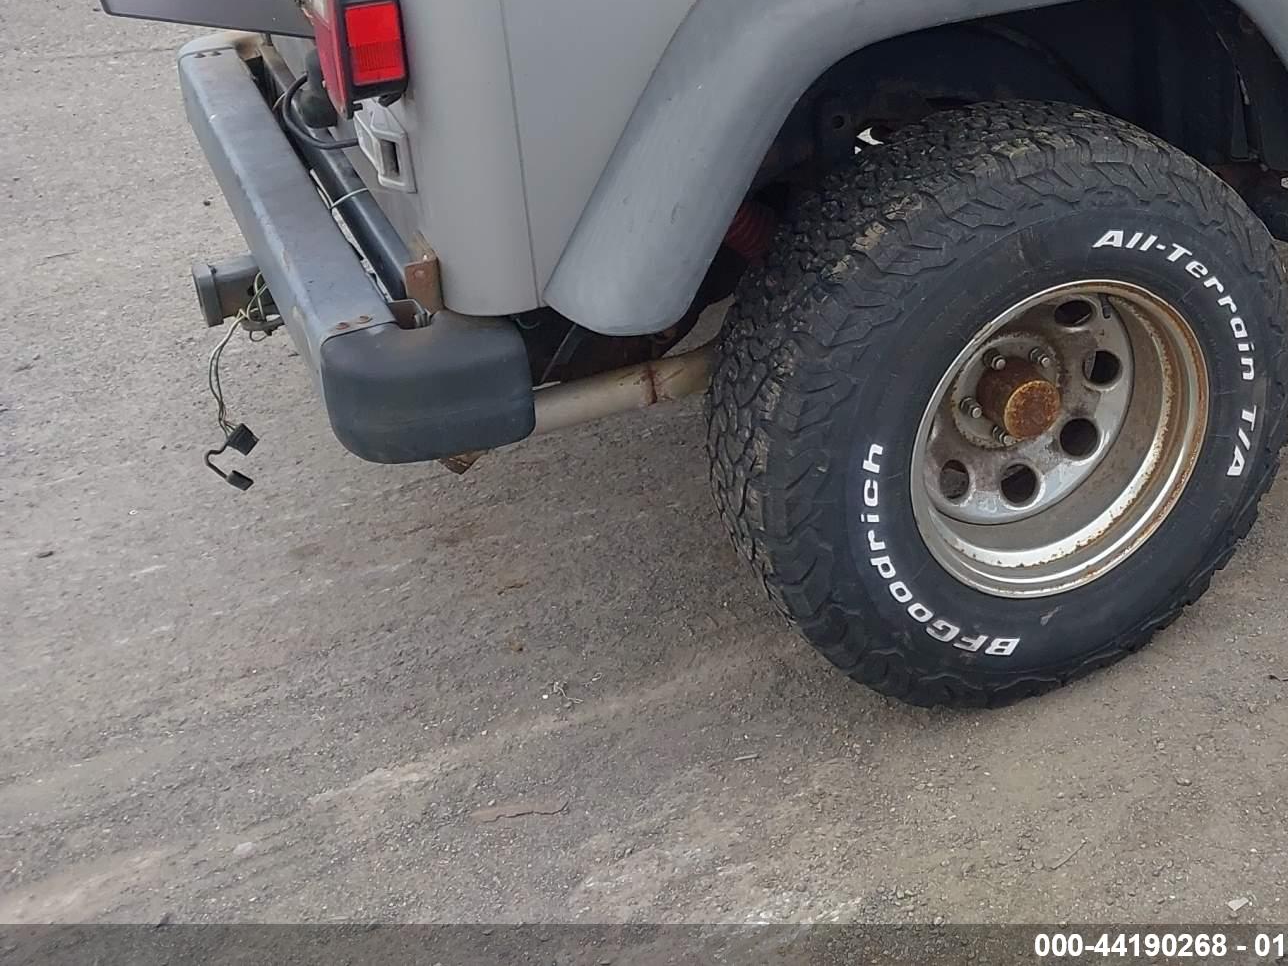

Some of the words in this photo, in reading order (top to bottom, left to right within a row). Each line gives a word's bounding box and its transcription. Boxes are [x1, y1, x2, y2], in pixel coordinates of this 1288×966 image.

[1093, 229, 1256, 382] All-Terrain
[1227, 404, 1258, 478] T/A
[862, 443, 1021, 657] BFGoodrich
